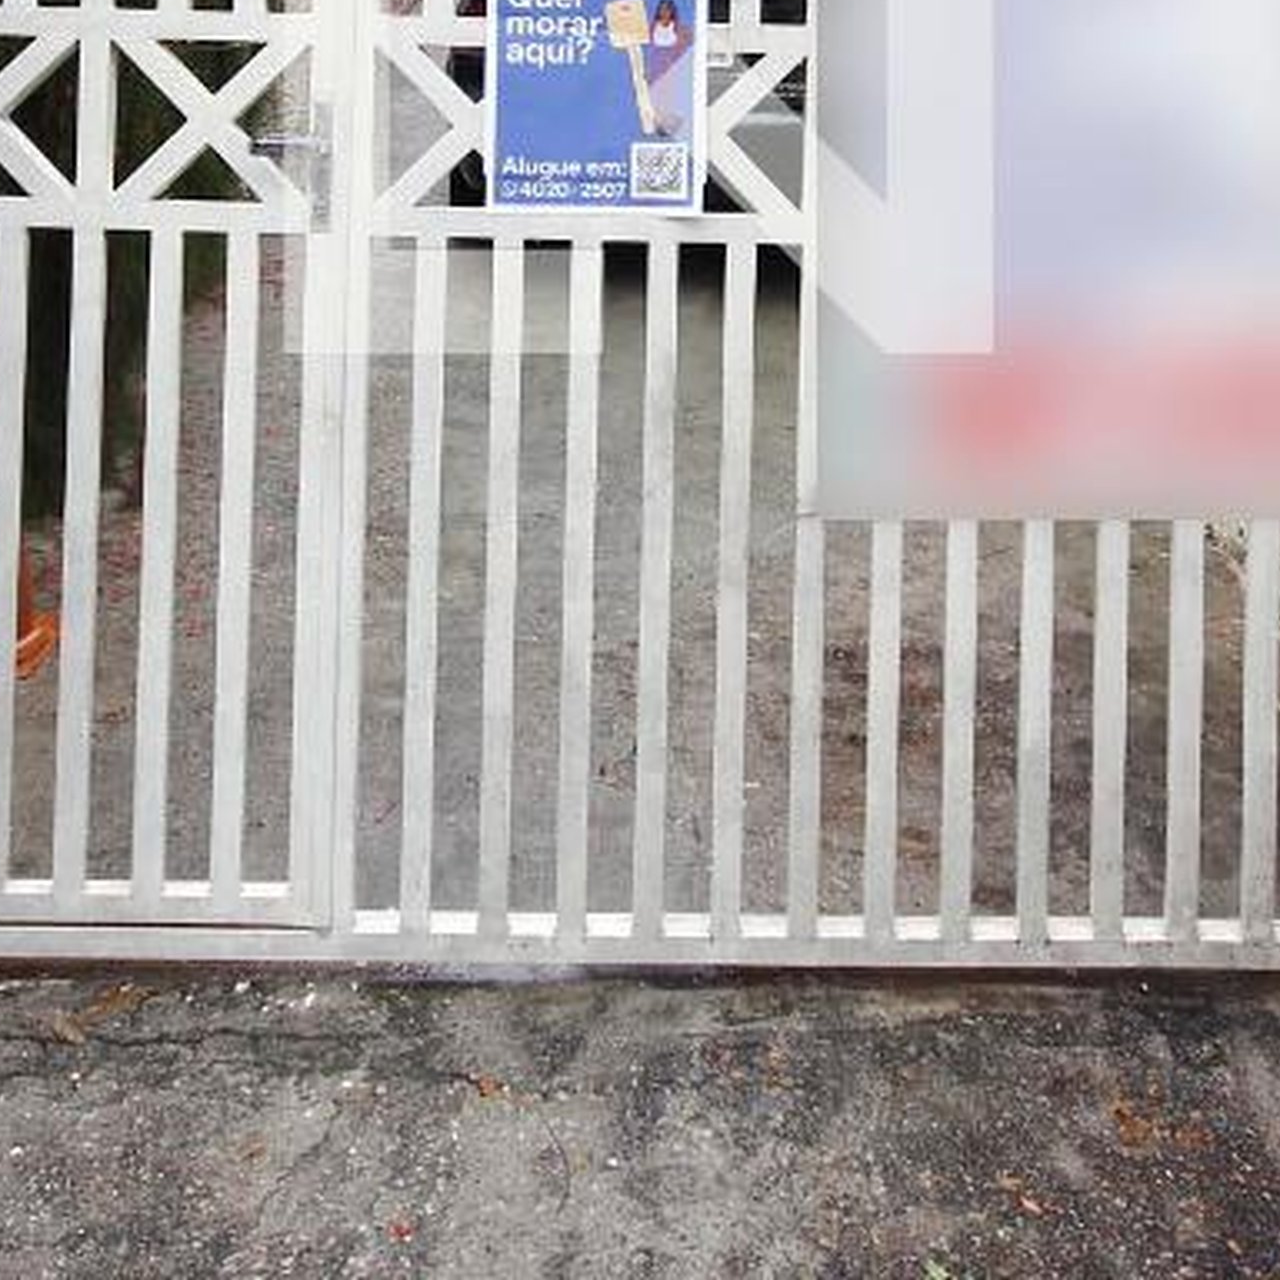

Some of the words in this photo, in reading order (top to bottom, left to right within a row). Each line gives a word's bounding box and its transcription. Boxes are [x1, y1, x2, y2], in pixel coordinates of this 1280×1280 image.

[505, 16, 603, 36] morar
[505, 38, 594, 69] aqui?
[502, 157, 582, 180] Alugue
[585, 161, 627, 178] em:
